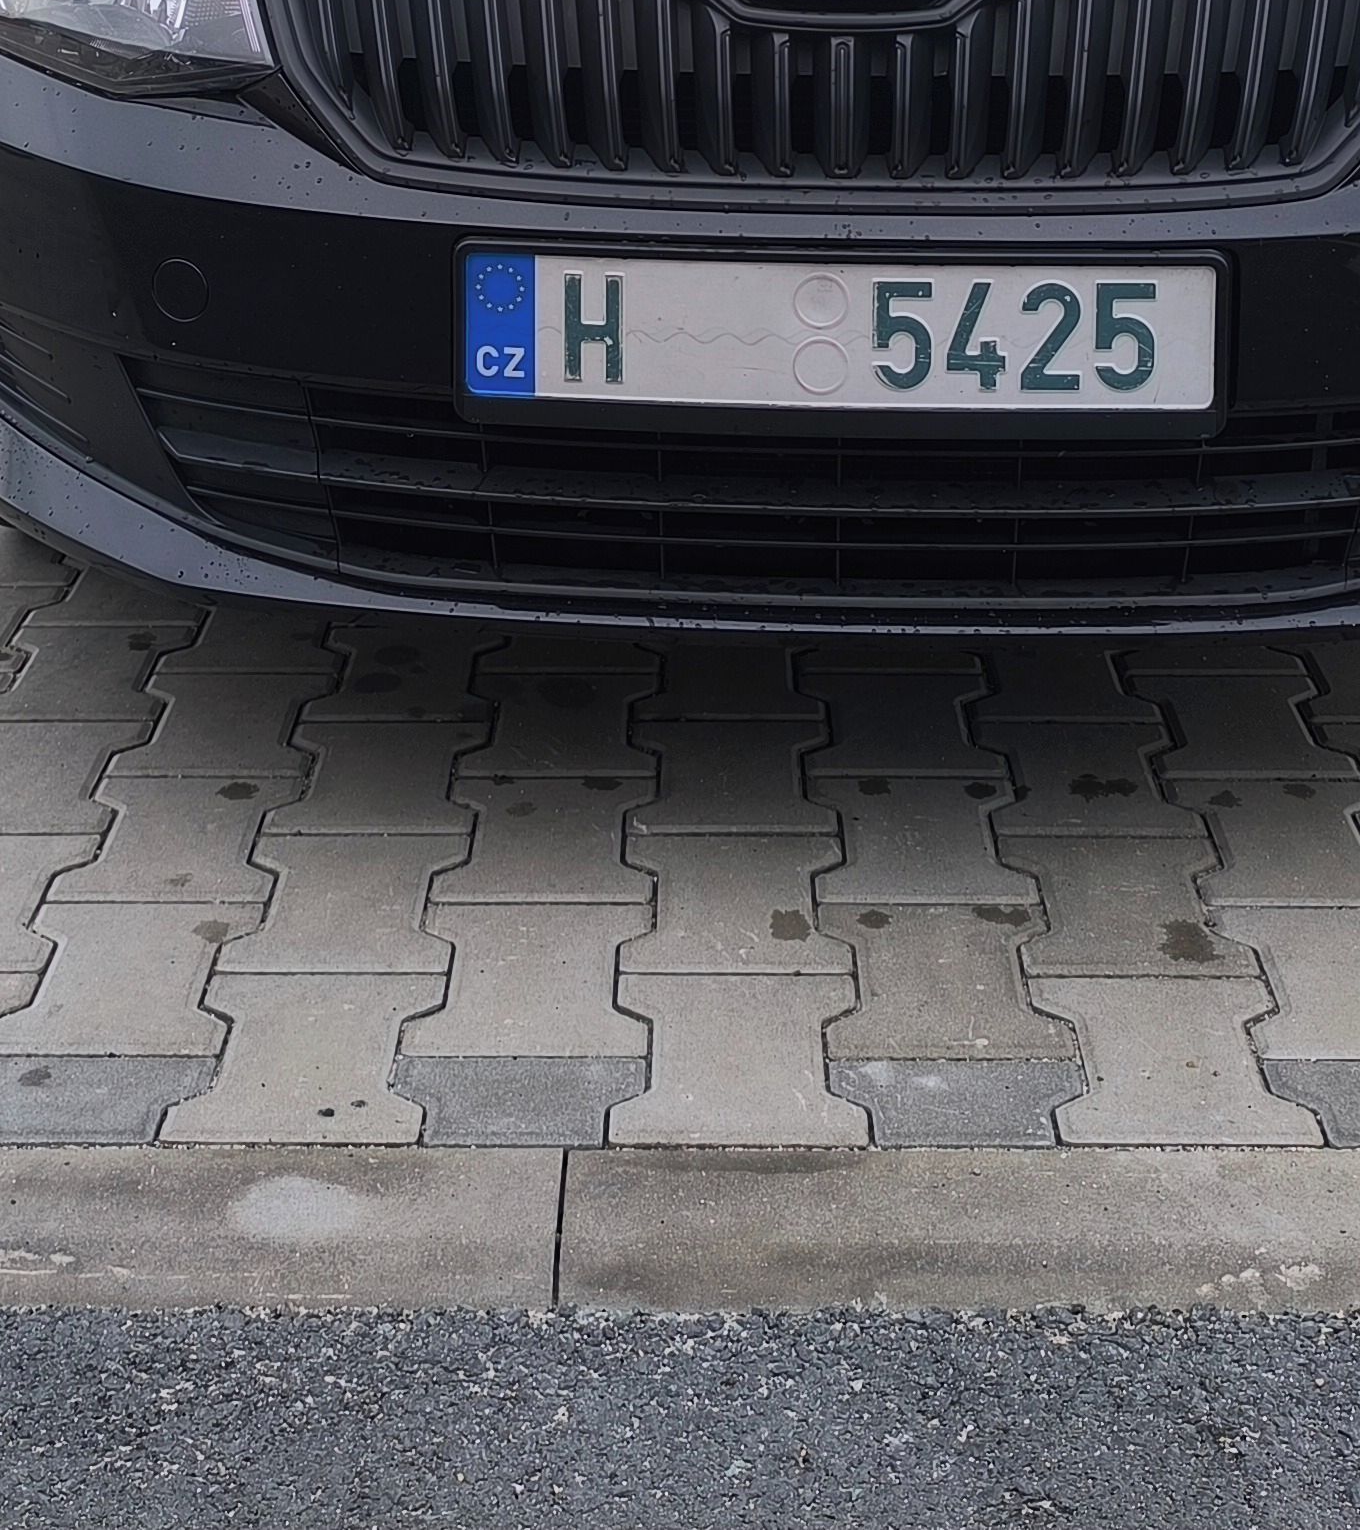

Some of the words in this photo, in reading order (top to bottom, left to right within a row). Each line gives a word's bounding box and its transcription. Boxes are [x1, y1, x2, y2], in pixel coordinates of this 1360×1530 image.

[475, 345, 526, 379] CZ
[563, 271, 625, 383] H
[872, 278, 1159, 392] 5425
